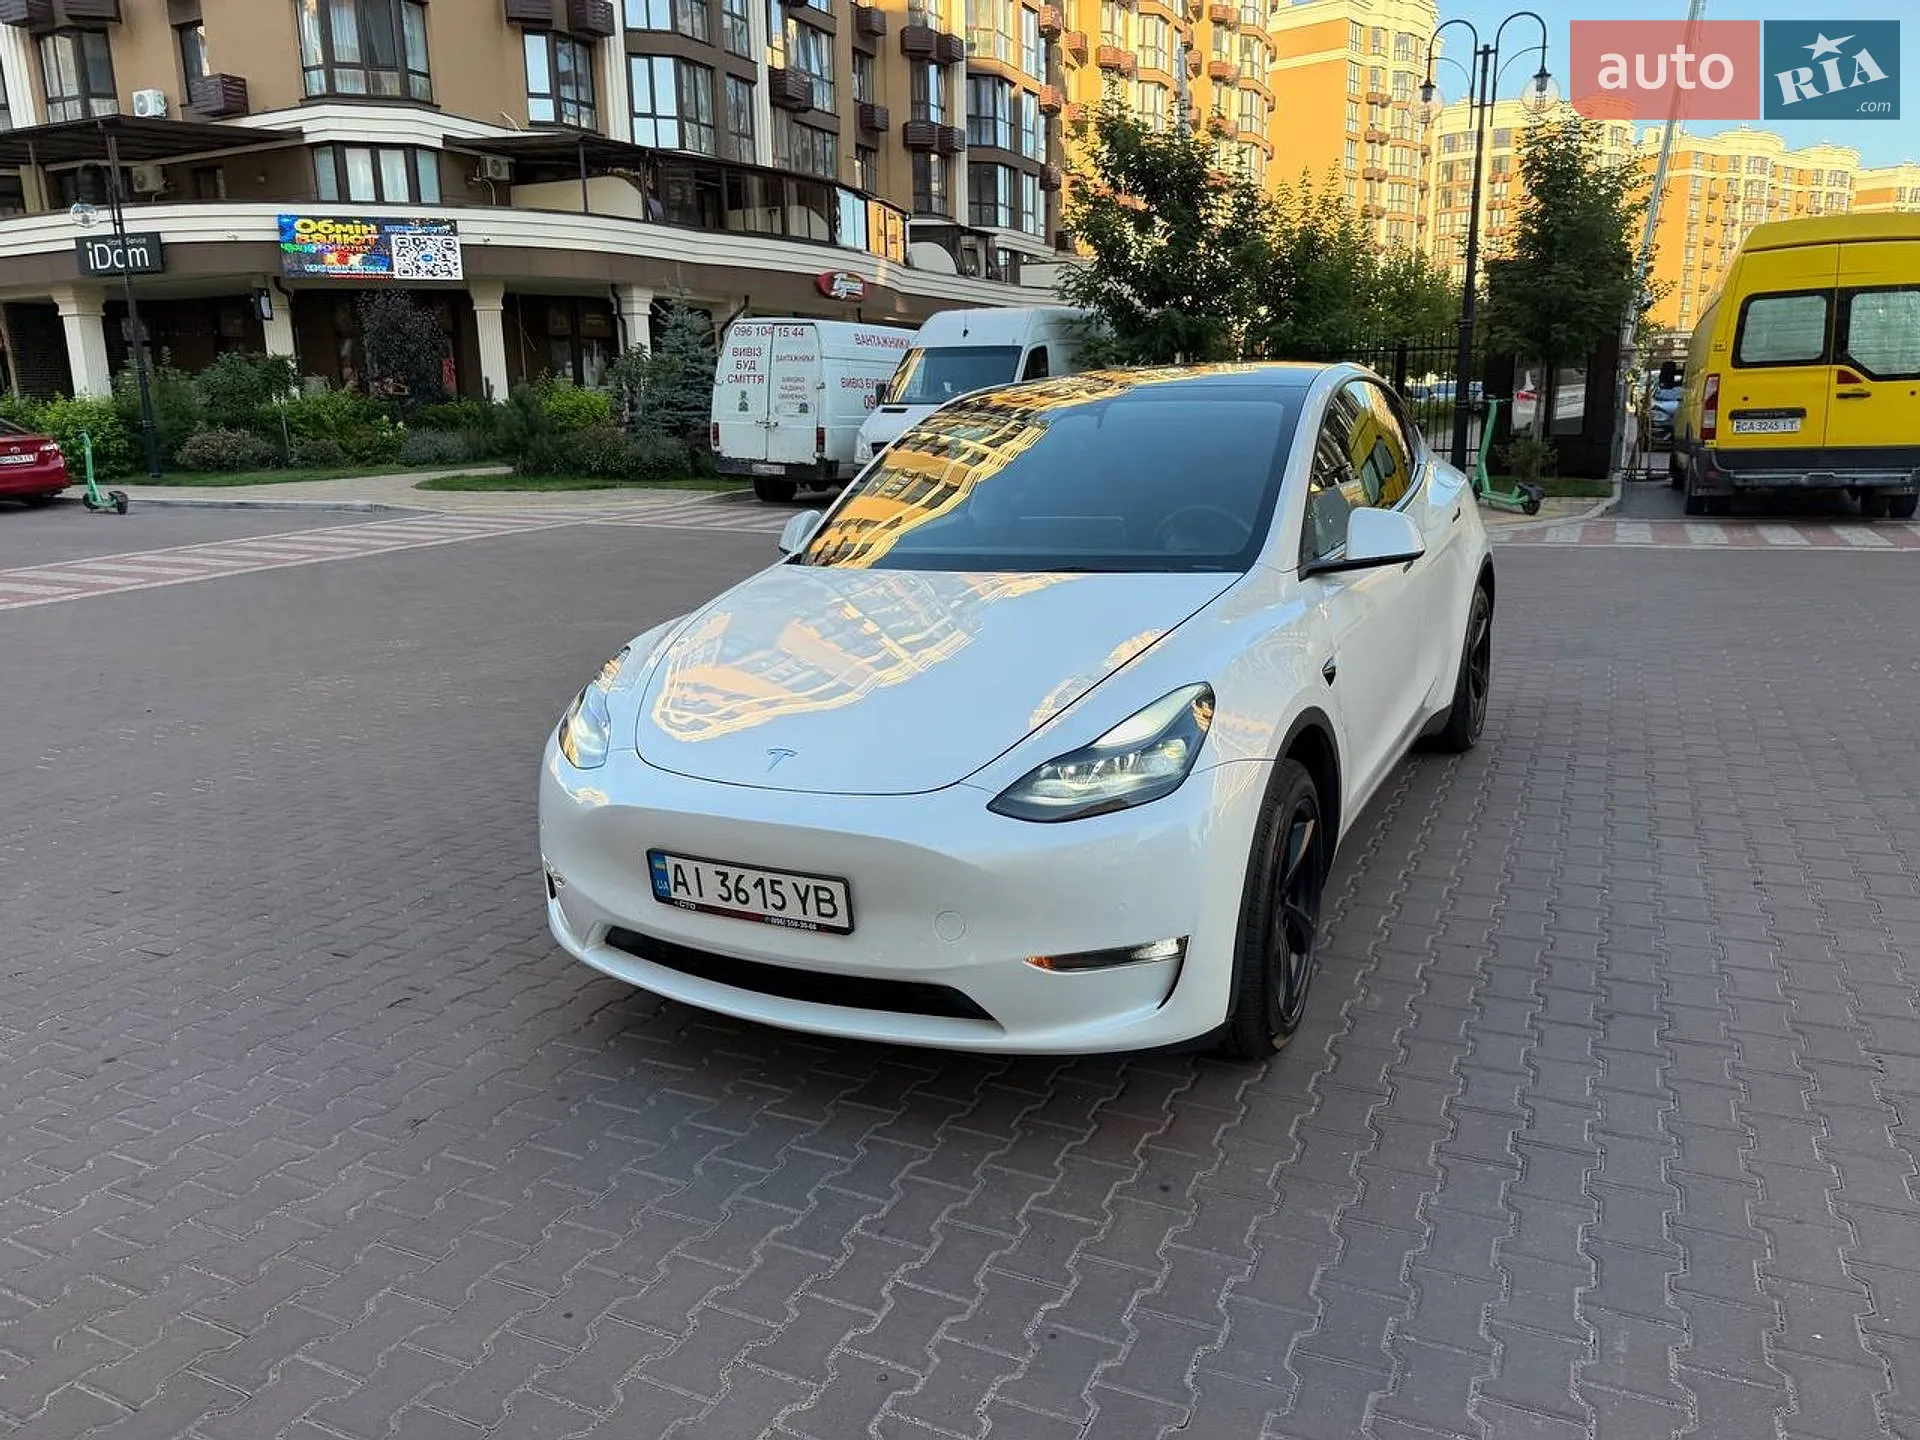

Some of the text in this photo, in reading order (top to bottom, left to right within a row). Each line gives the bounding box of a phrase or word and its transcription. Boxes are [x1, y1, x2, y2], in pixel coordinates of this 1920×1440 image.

[733, 325, 753, 337] 096
[778, 327, 789, 337] 15
[792, 327, 804, 337] 44
[732, 346, 762, 357] ВИВІЗ
[736, 359, 757, 372] БУД
[727, 373, 765, 385] СМІТТЯ
[673, 863, 839, 919] AI 3615 YB
